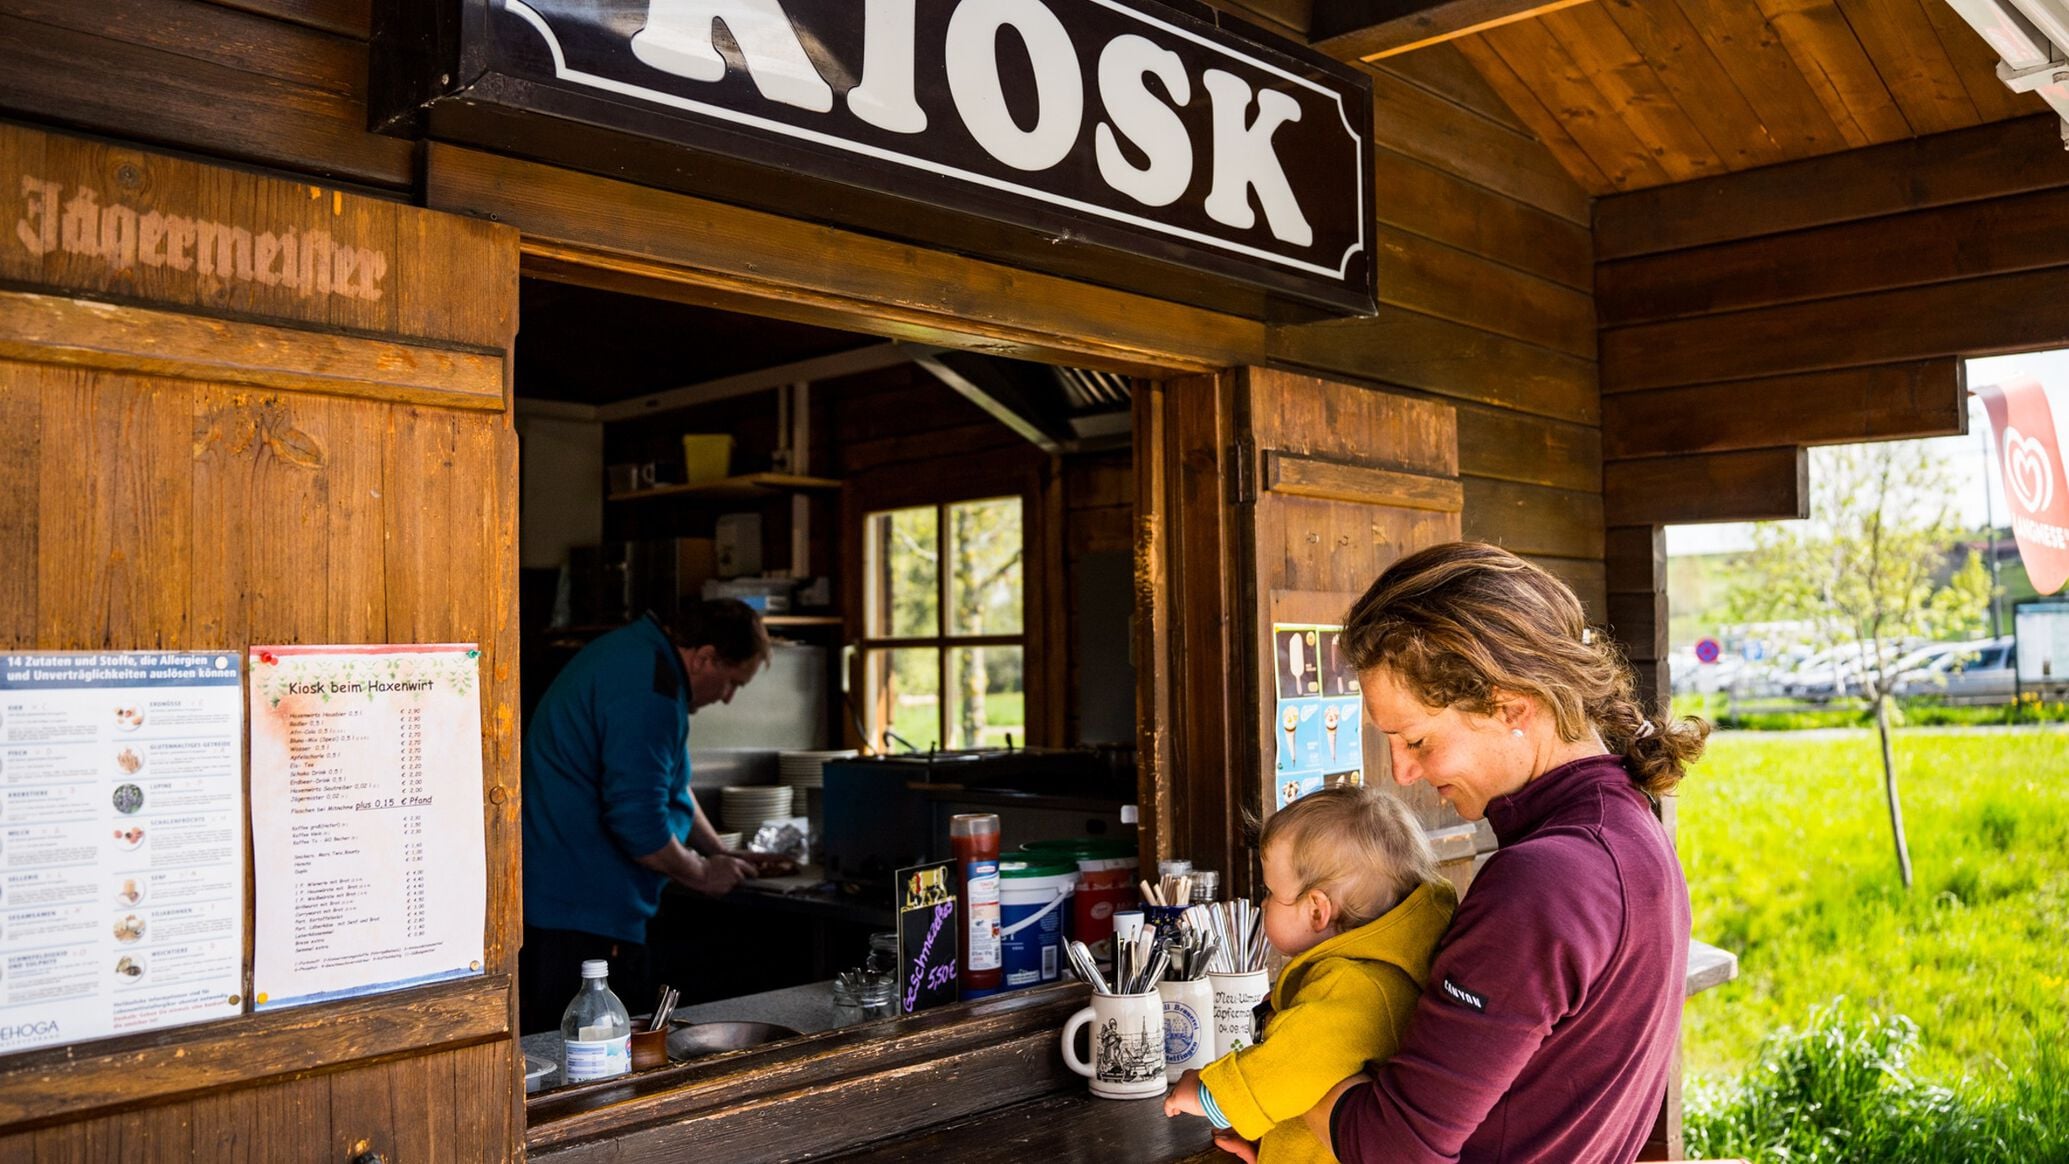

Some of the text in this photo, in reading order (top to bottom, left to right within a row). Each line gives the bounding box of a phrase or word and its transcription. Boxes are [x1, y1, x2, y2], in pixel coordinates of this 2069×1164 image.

[7, 655, 208, 667] 14 Zutaten und Stoffe, die Allergien
[7, 667, 237, 682] und Unverträglichkeiten auslösen können
[289, 679, 434, 695] Kiosk beim Haxenwirt
[355, 799, 372, 811] plus
[374, 798, 395, 809] 0,15
[401, 797, 408, 805] €
[409, 796, 433, 805] Pfand
[1443, 979, 1482, 1009] CANYON
[0, 1020, 60, 1040] EHOGA
